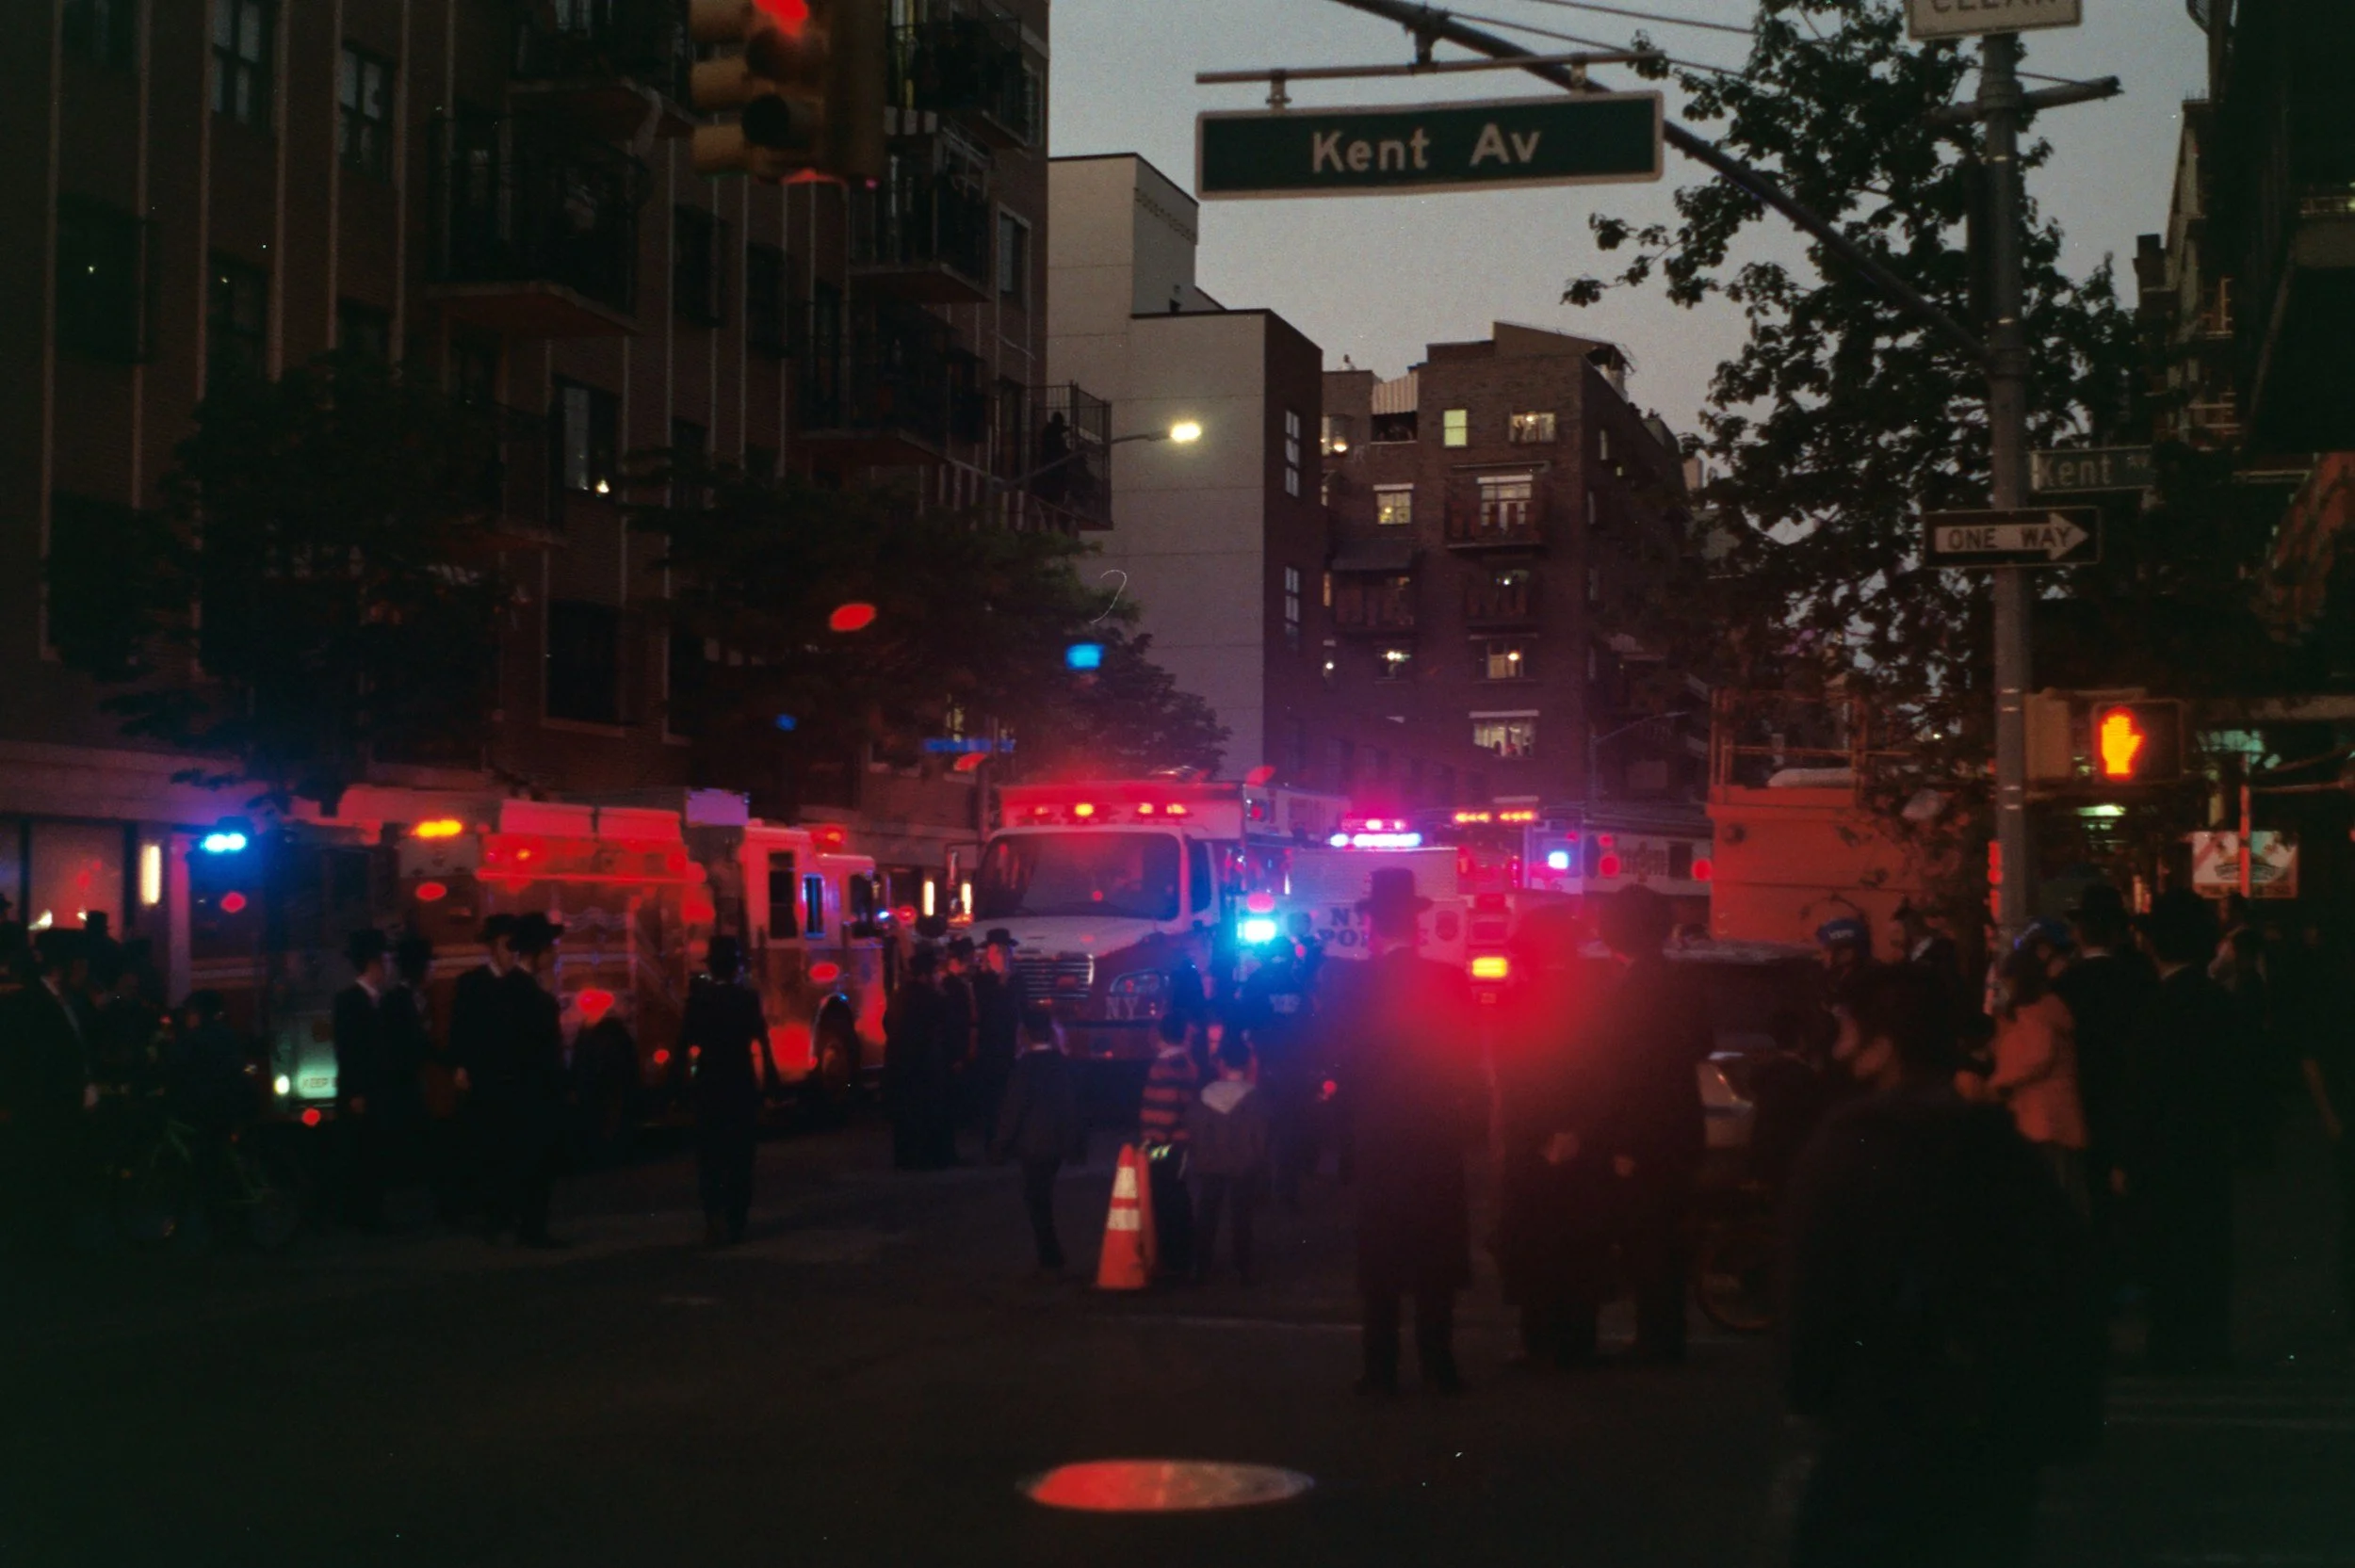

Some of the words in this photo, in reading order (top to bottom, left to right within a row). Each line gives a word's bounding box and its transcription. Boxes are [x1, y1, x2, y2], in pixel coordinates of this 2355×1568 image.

[1932, 0, 2056, 13] CLE
[1312, 126, 1431, 174] Kent
[1469, 121, 1541, 168] Av
[2038, 453, 2112, 488] Kent
[1948, 527, 1998, 550] ONE
[2021, 525, 2072, 549] WAY
